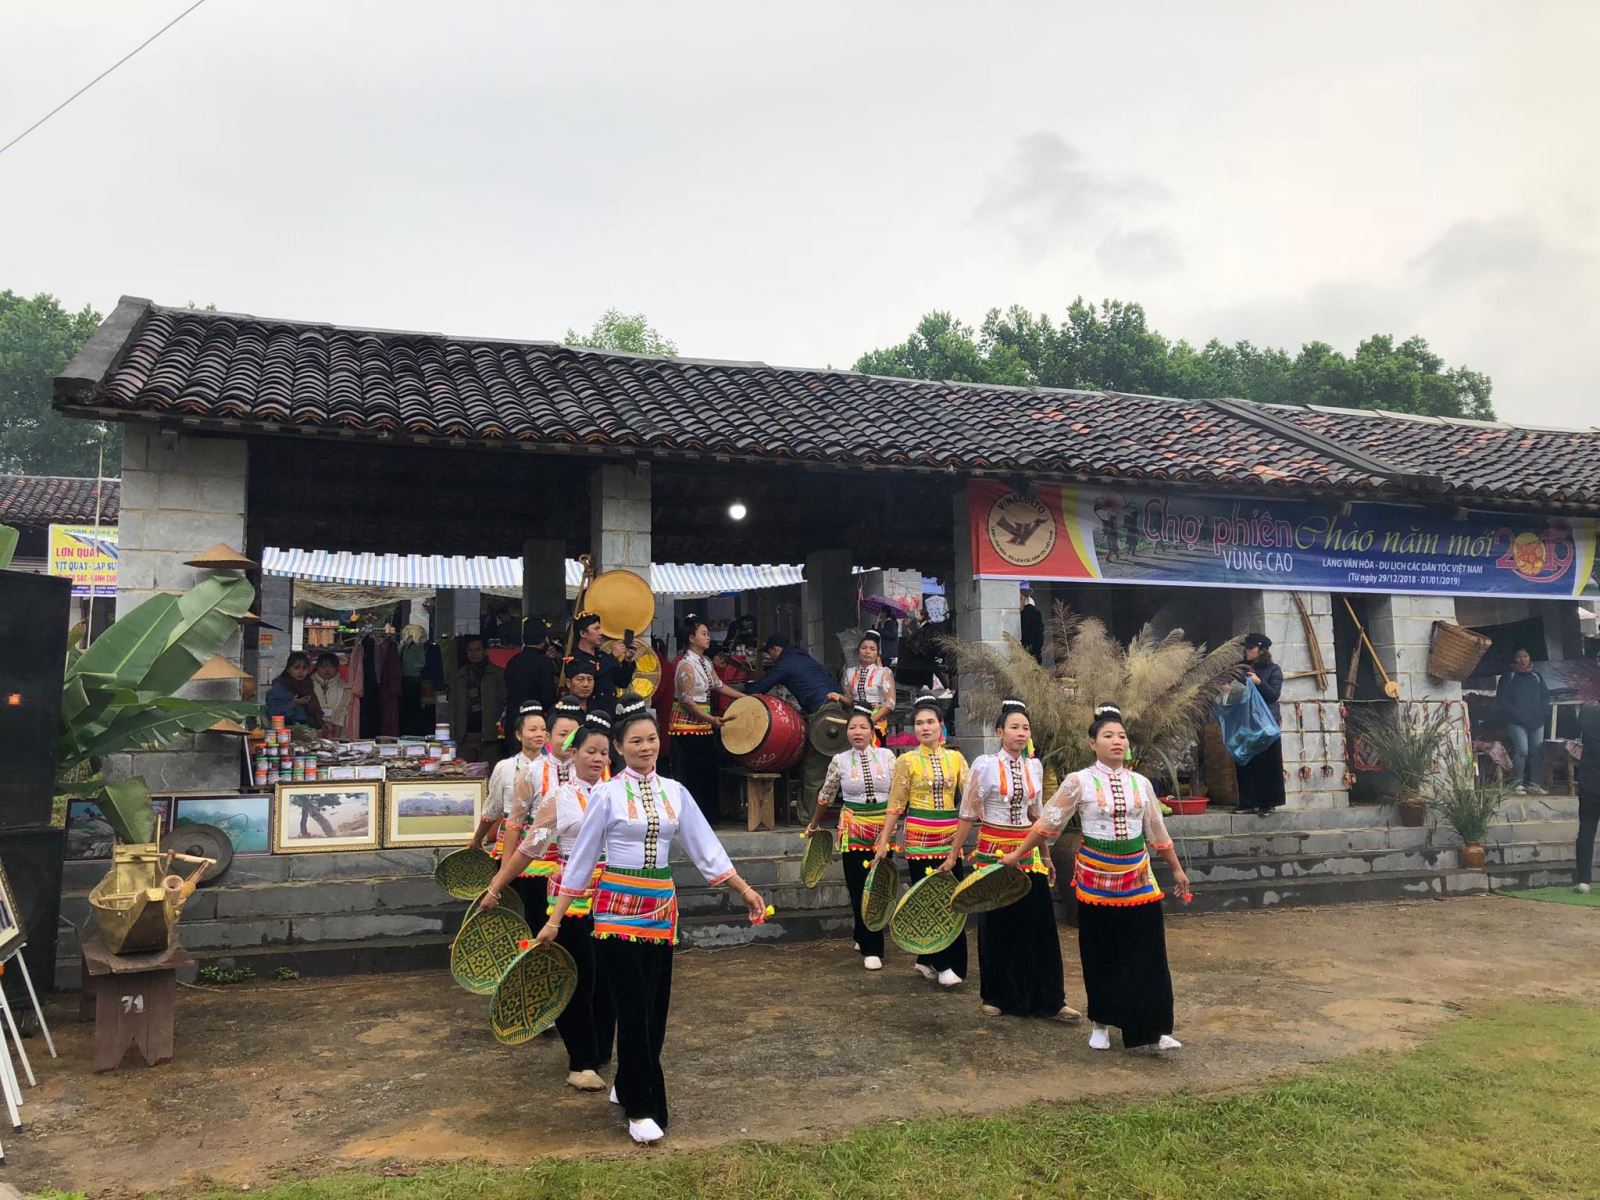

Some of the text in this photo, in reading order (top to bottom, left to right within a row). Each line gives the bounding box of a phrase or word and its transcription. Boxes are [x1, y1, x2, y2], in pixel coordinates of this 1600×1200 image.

[1143, 497, 1203, 550] Chợ
[1295, 514, 1374, 551] Chào
[1383, 525, 1438, 556] năm
[1448, 529, 1496, 558] mới
[1223, 547, 1293, 572] VÙNG CAO
[1360, 560, 1374, 569] HÓA
[1379, 561, 1391, 571] DU
[1391, 562, 1406, 573] LỊCH
[1407, 561, 1420, 571] CÁC
[1421, 562, 1436, 572] DÂN
[1437, 564, 1450, 575] TỘC
[1452, 564, 1466, 575] VIỆT
[1466, 565, 1483, 574] NAM
[1360, 574, 1377, 584] ngày
[1378, 574, 1416, 585] 29/12/2018
[1421, 577, 1461, 586] 01/01/2019)
